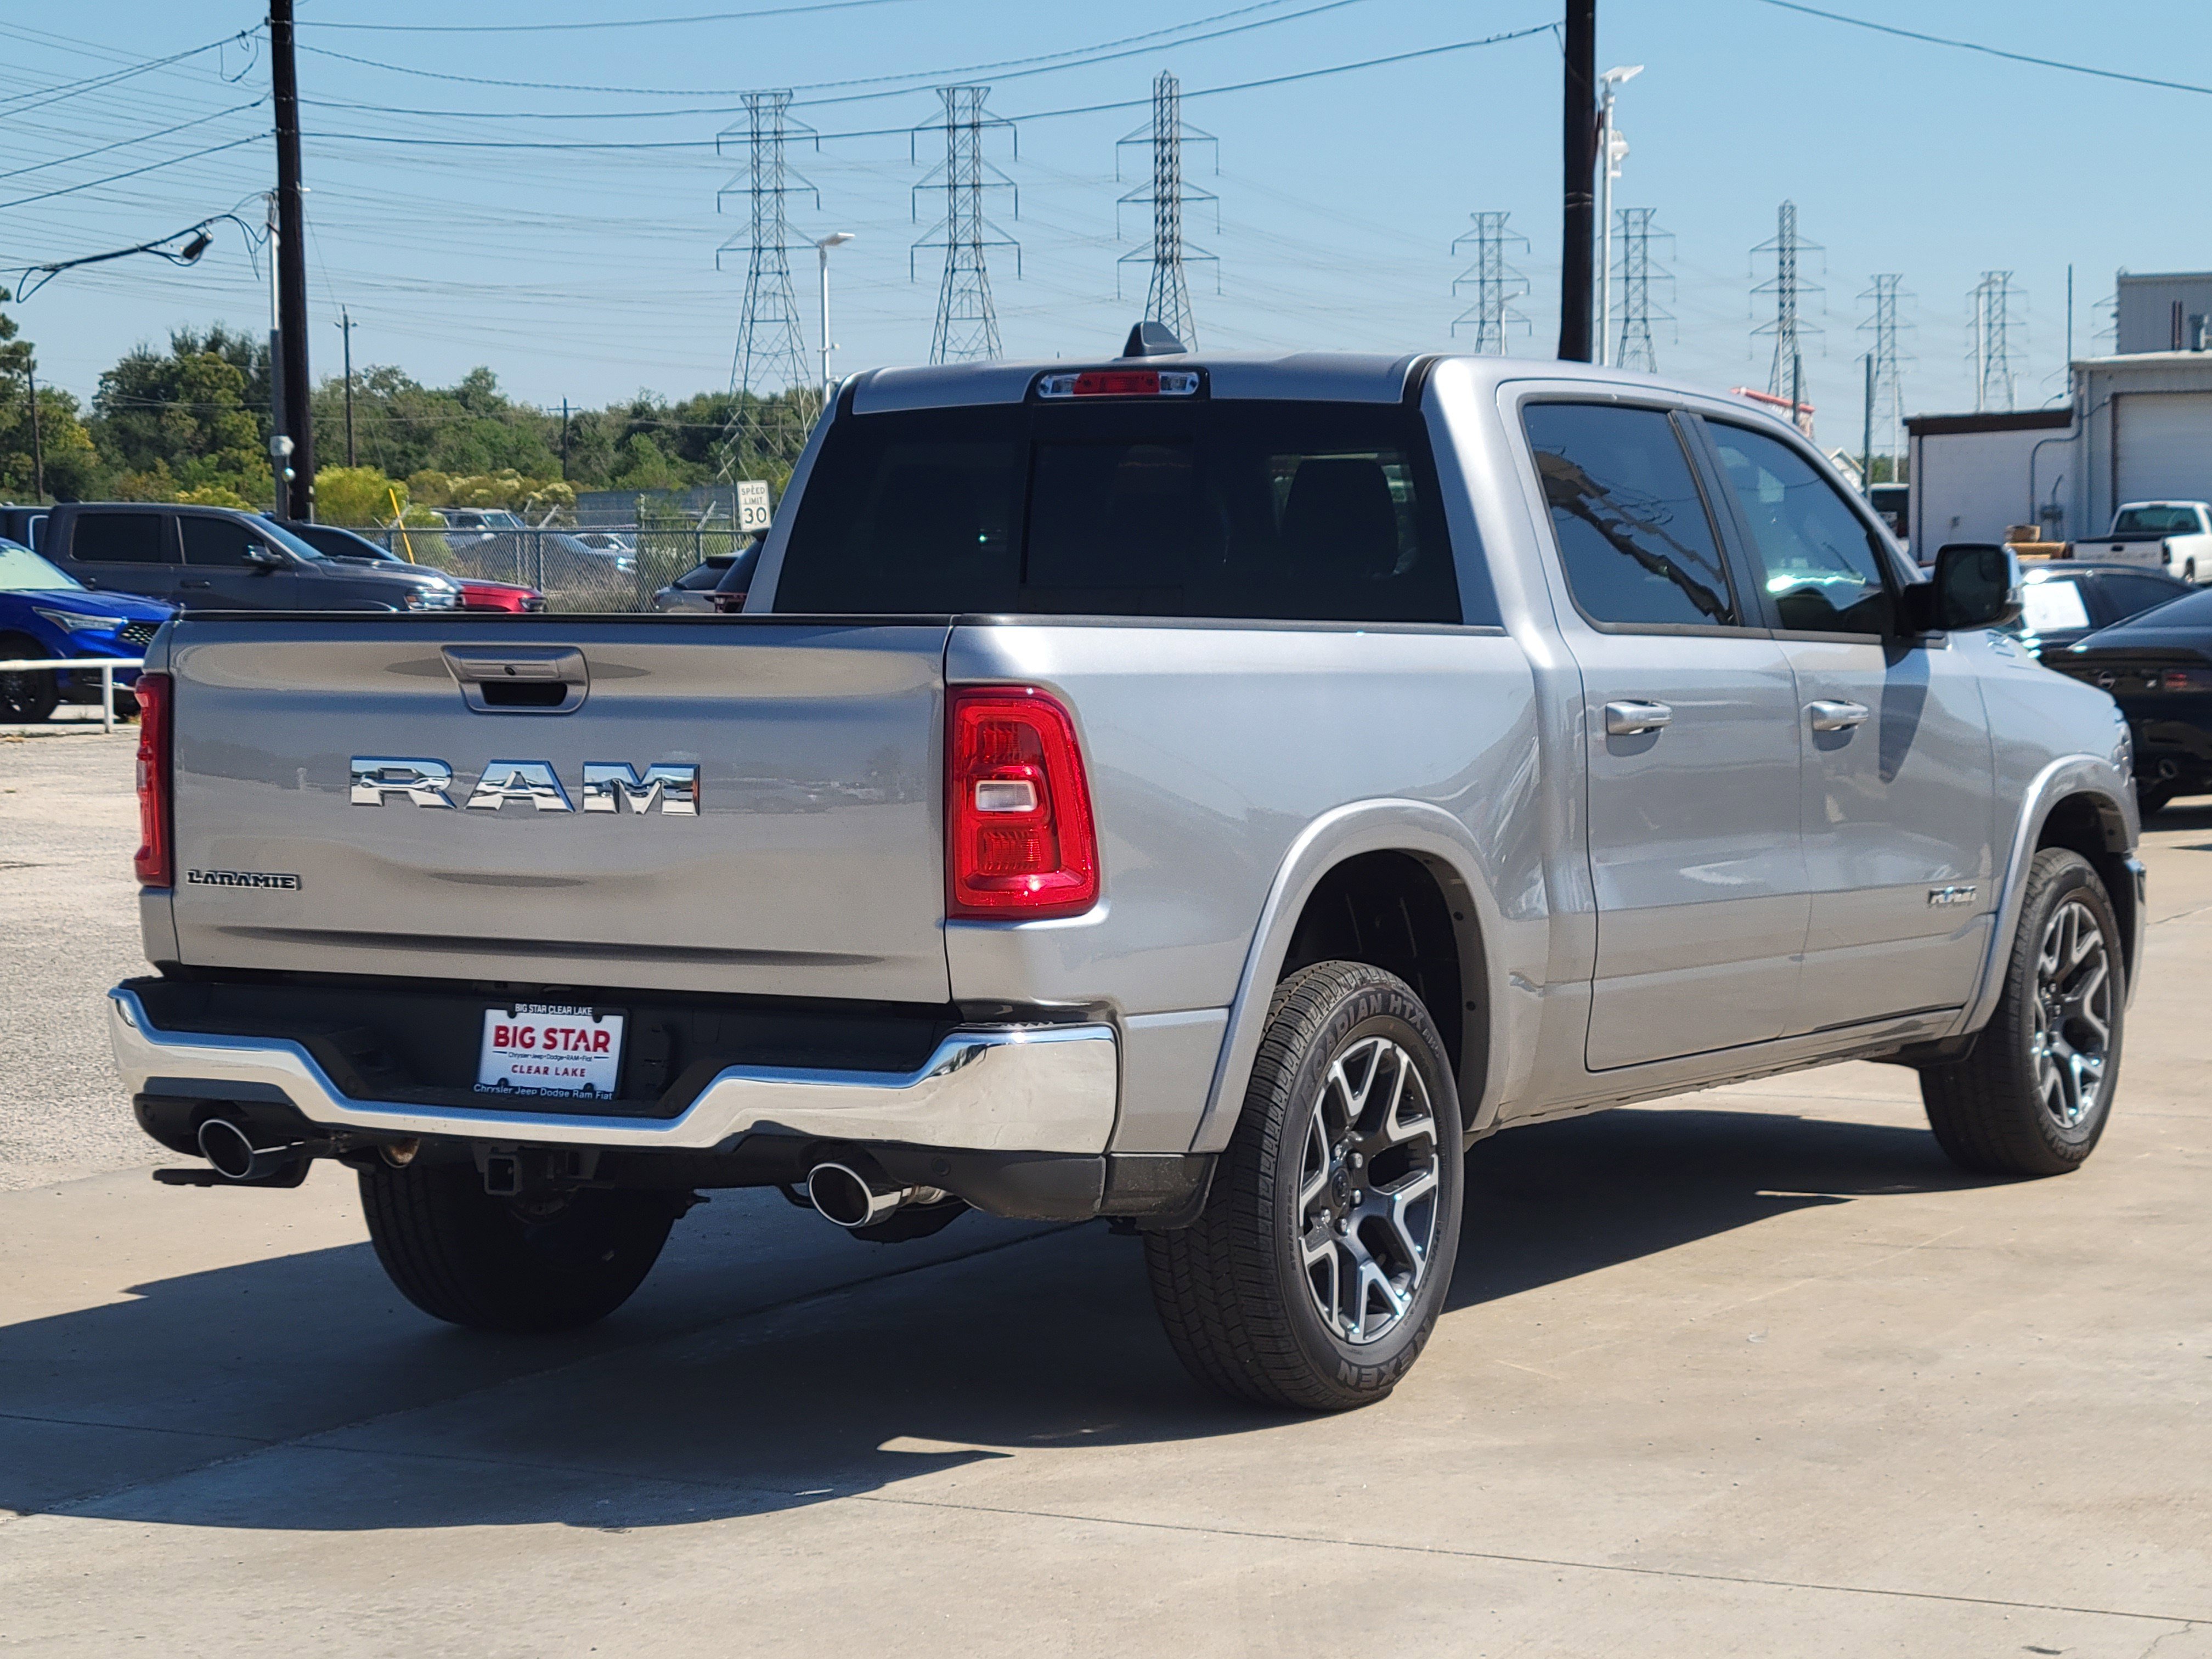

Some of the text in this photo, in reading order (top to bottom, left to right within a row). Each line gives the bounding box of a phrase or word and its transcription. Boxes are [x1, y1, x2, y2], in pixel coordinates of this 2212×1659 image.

[741, 487, 765, 495] SPEED
[744, 496, 763, 505] LIMIT
[744, 506, 767, 524] 30
[350, 754, 701, 817] RAM
[187, 870, 300, 890] LARAMIE
[515, 1003, 593, 1015] BIG STAR CLEAR LAKE
[1389, 994, 1424, 1030] HTX
[493, 1025, 611, 1053] BIG STAR
[511, 1064, 586, 1077] CLEAR LAKE
[473, 1084, 613, 1101] Chrysler Jeep Dodge Ram Fiat
[1338, 1314, 1435, 1389] NEXEN
